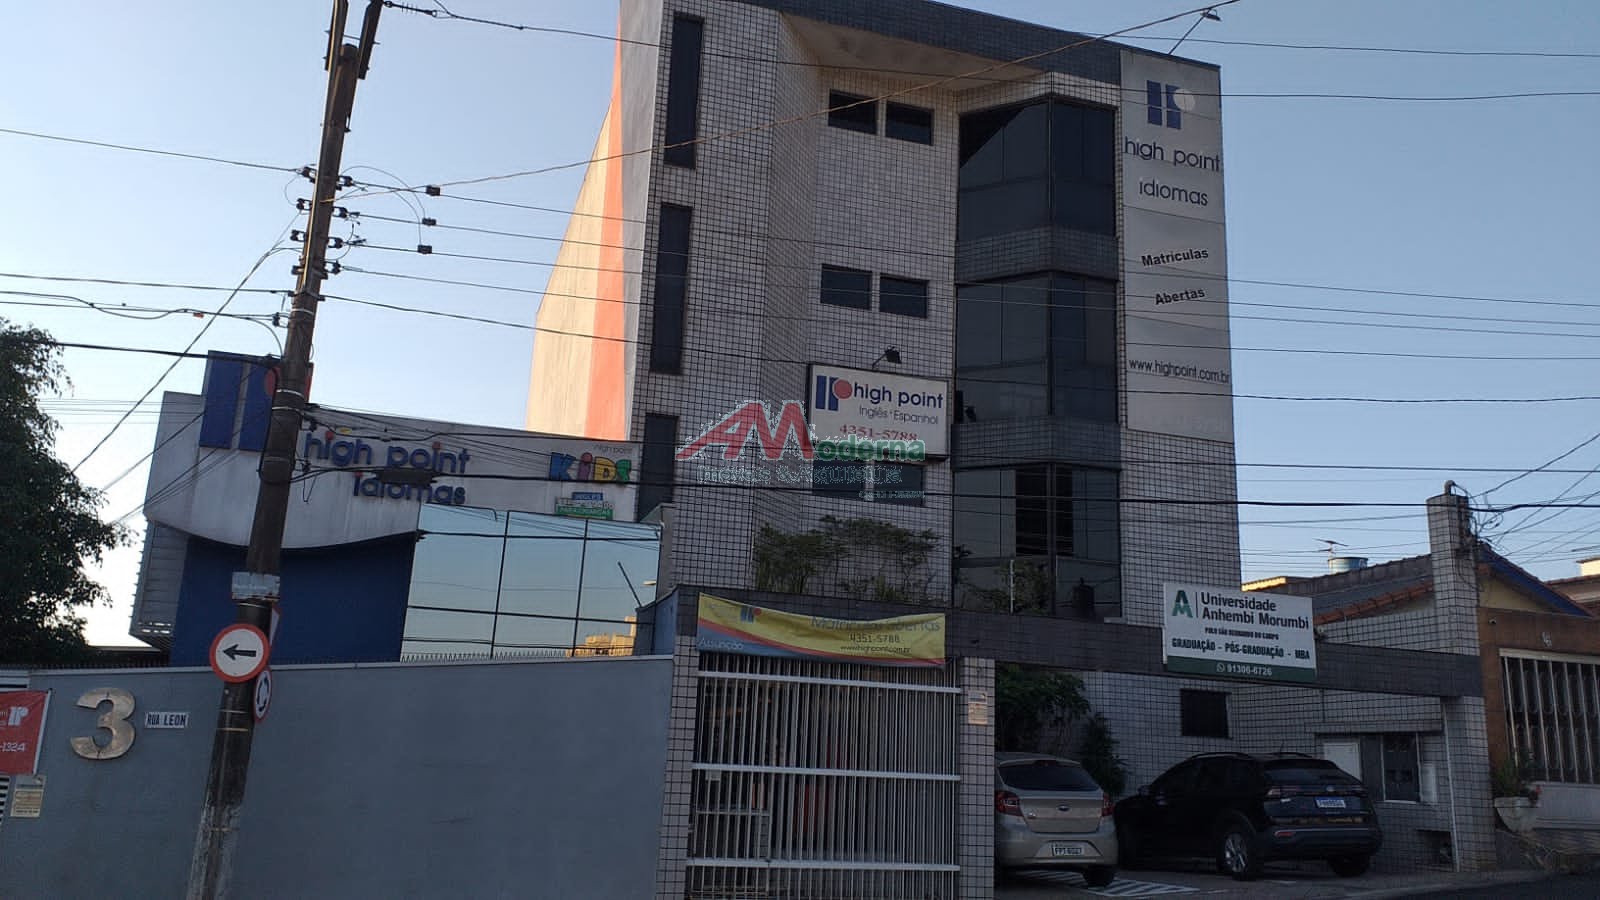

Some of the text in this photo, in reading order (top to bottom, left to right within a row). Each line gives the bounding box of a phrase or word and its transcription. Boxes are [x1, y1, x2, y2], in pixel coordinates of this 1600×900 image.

[1125, 136, 1221, 172] high point
[1139, 178, 1208, 206] idiomas
[1155, 288, 1205, 305] Abertas
[854, 382, 943, 409] high point
[893, 410, 938, 425] Espanhol
[304, 431, 472, 473] high point
[1201, 592, 1277, 611] Universidade
[1203, 608, 1309, 629] Anhembi Morumbi
[71, 687, 136, 760] 3
[148, 713, 186, 726] RUA LEON
